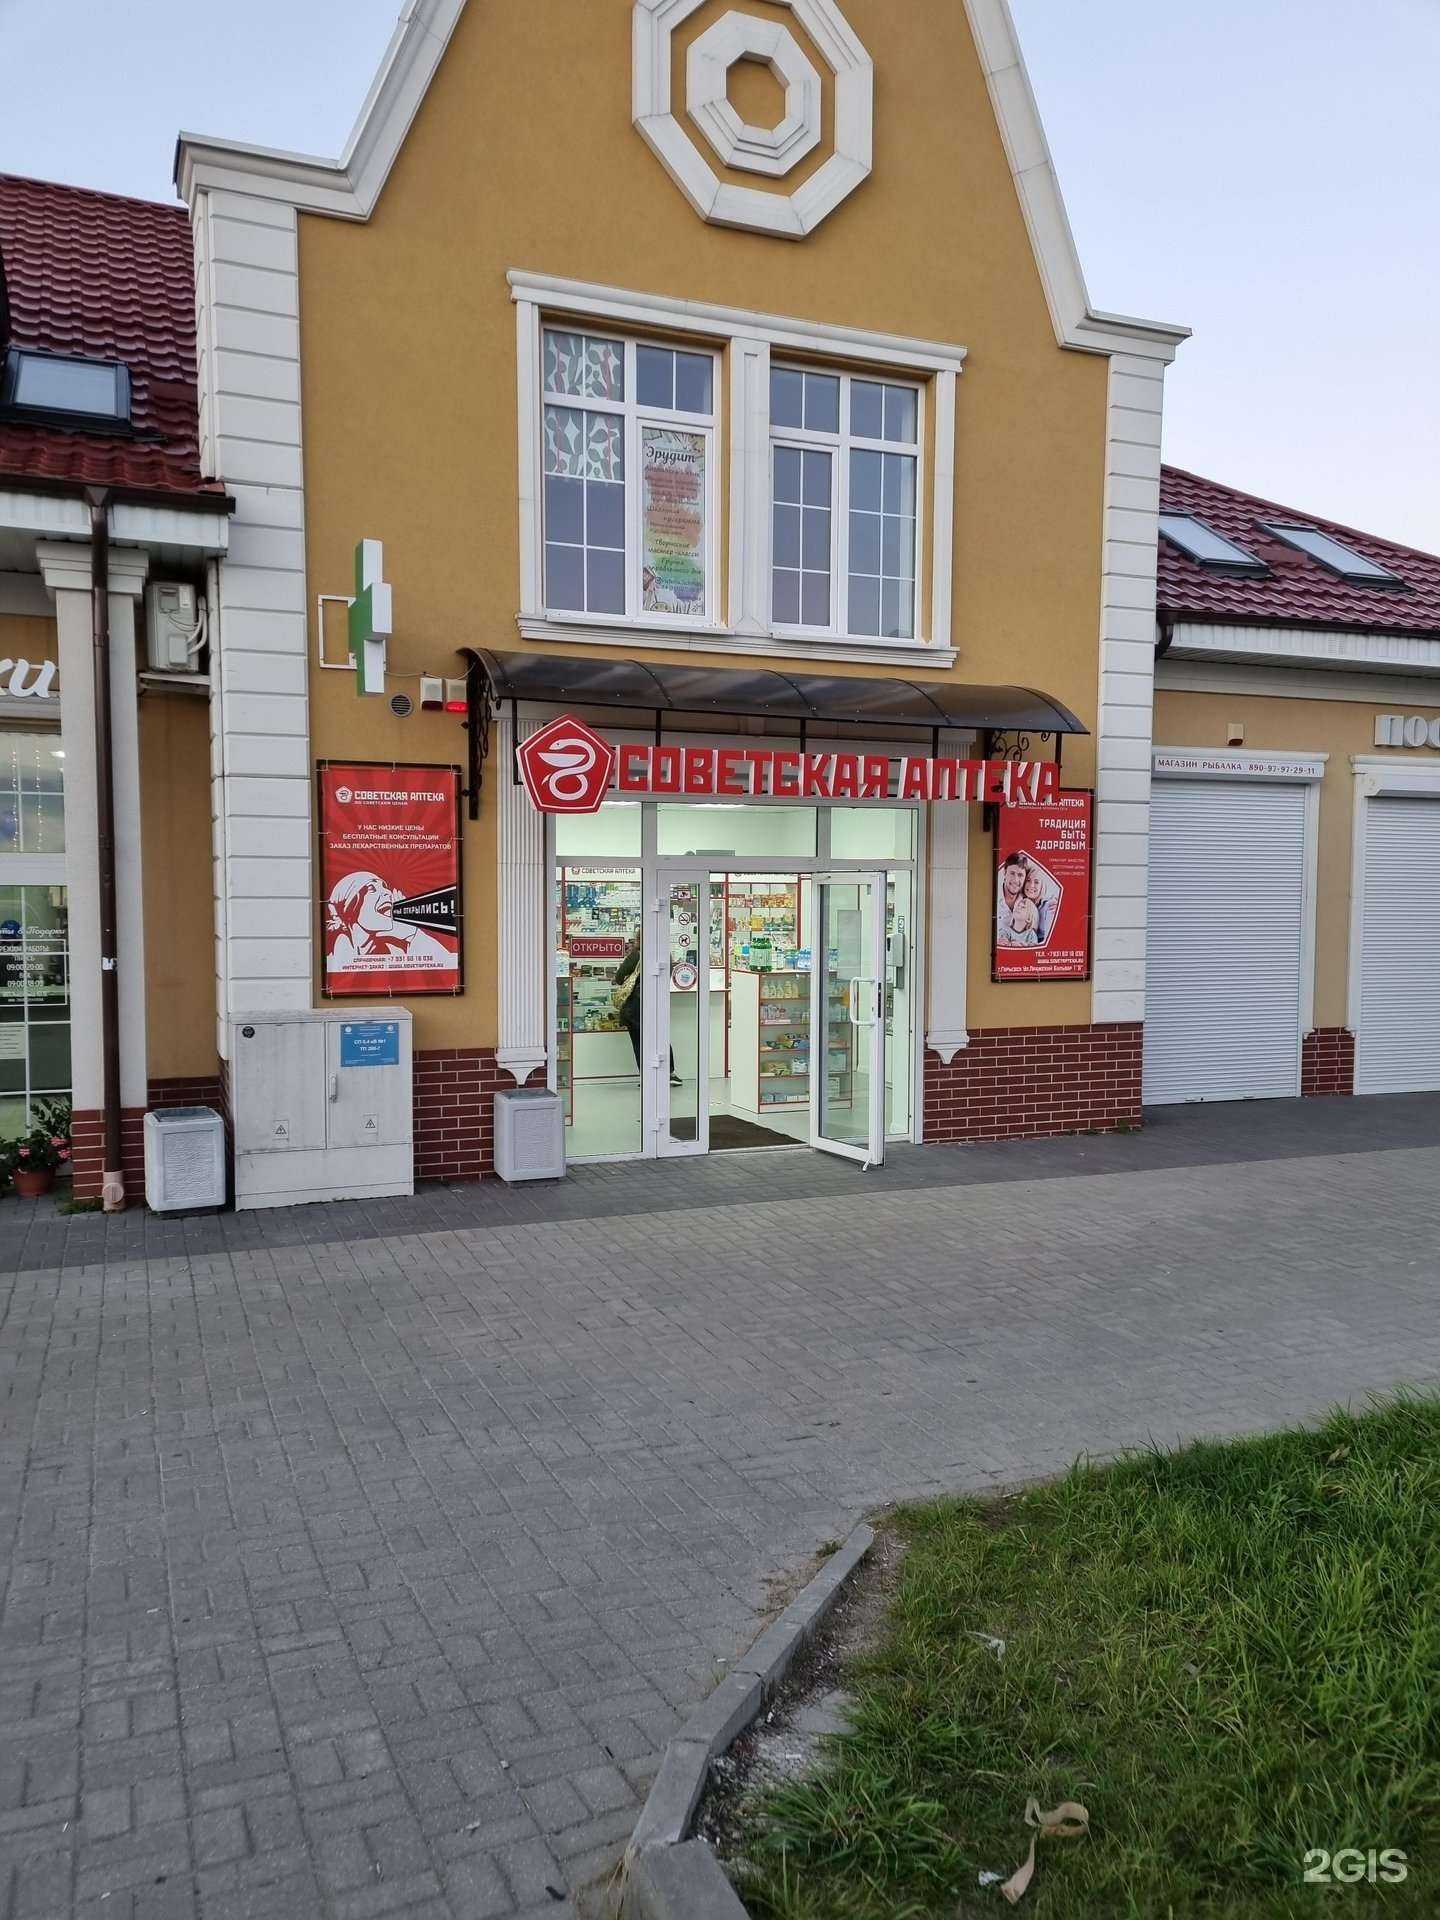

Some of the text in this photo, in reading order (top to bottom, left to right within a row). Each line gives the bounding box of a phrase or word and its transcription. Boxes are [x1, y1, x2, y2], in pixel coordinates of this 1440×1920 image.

[646, 446, 696, 465] Эрудит
[1157, 758, 1316, 775] МАГАЗИН РЫБАЛКА 890-97-97-29-11
[618, 745, 1061, 803] СОВЕТСКАЯ АПТЕКА
[354, 790, 445, 802] СОВЕТСКАЯ АПТЕКА
[1059, 798, 1084, 807] АПТЕКА
[1039, 818, 1086, 829] ТРАДИЦИЯ
[1061, 830, 1086, 839] БЫТЬ
[1035, 840, 1086, 850] ЗДОРОВЫМ
[403, 900, 455, 915] ОТКРЫЛИСЬ!
[572, 943, 622, 952] ОТКРЫТО
